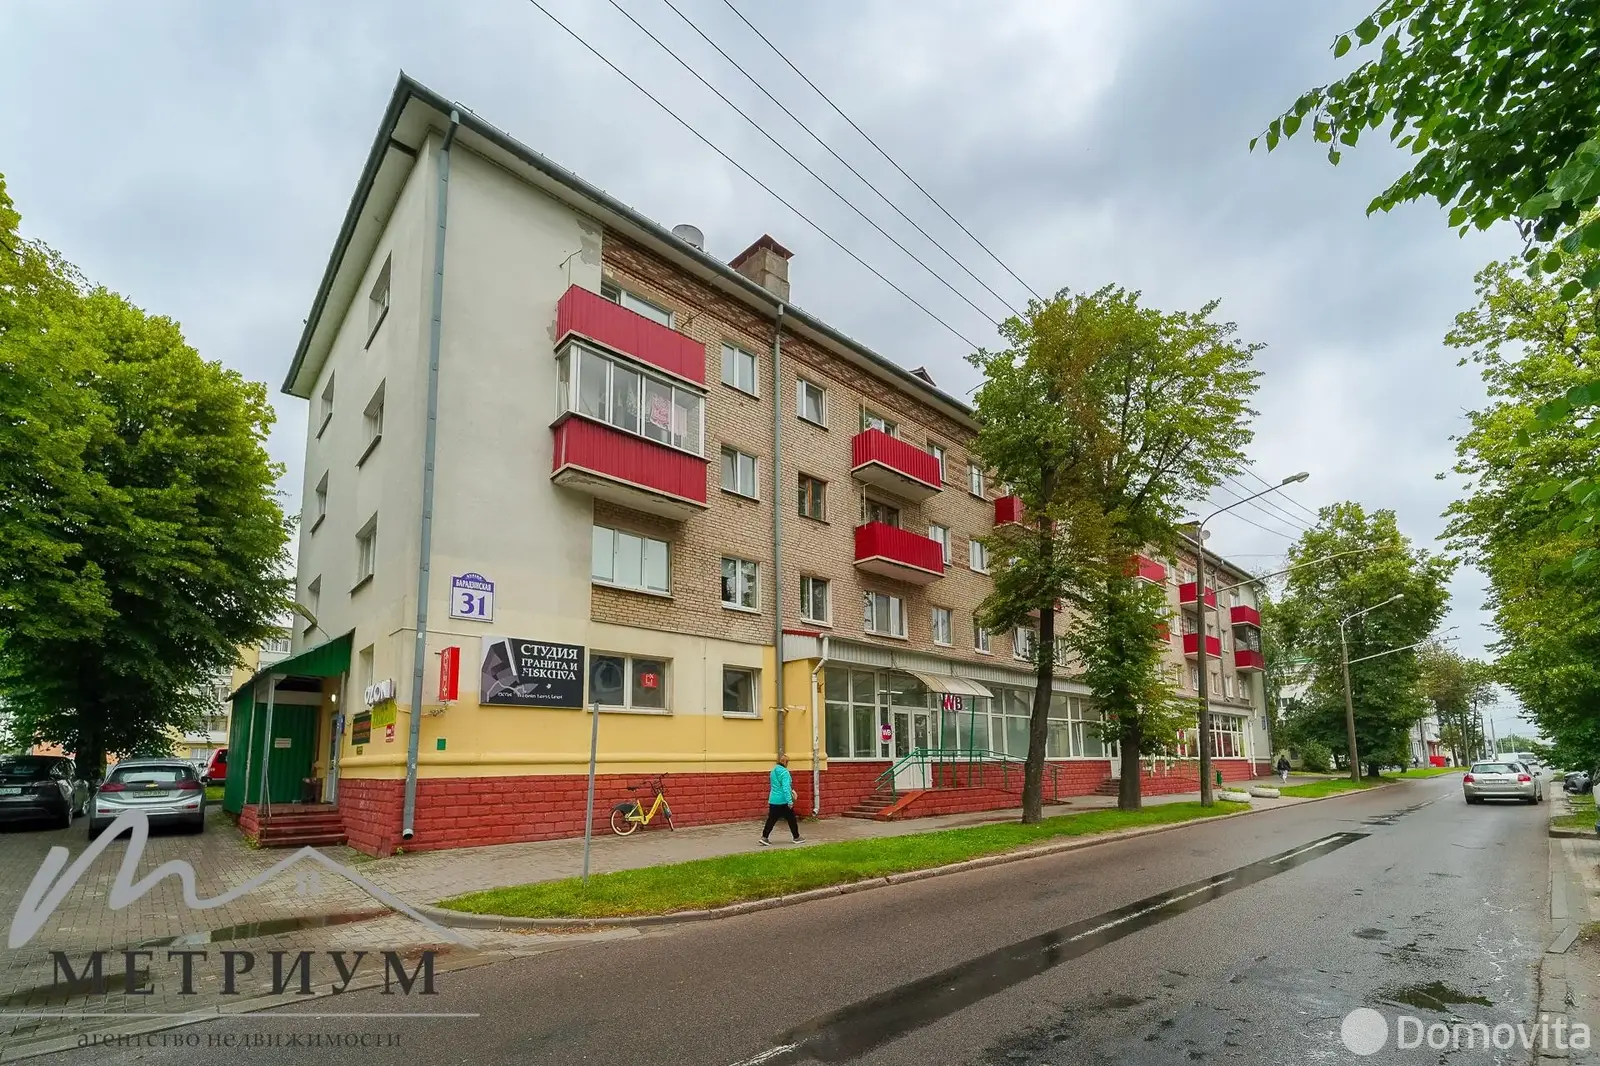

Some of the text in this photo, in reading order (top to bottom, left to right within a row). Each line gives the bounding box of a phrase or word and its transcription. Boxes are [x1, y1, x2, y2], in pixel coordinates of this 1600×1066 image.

[460, 592, 485, 616] 31
[520, 643, 578, 660] СТУДИЯ
[521, 658, 578, 671] ГРАНИТА И
[364, 680, 392, 705] OZON
[943, 693, 962, 711] WB
